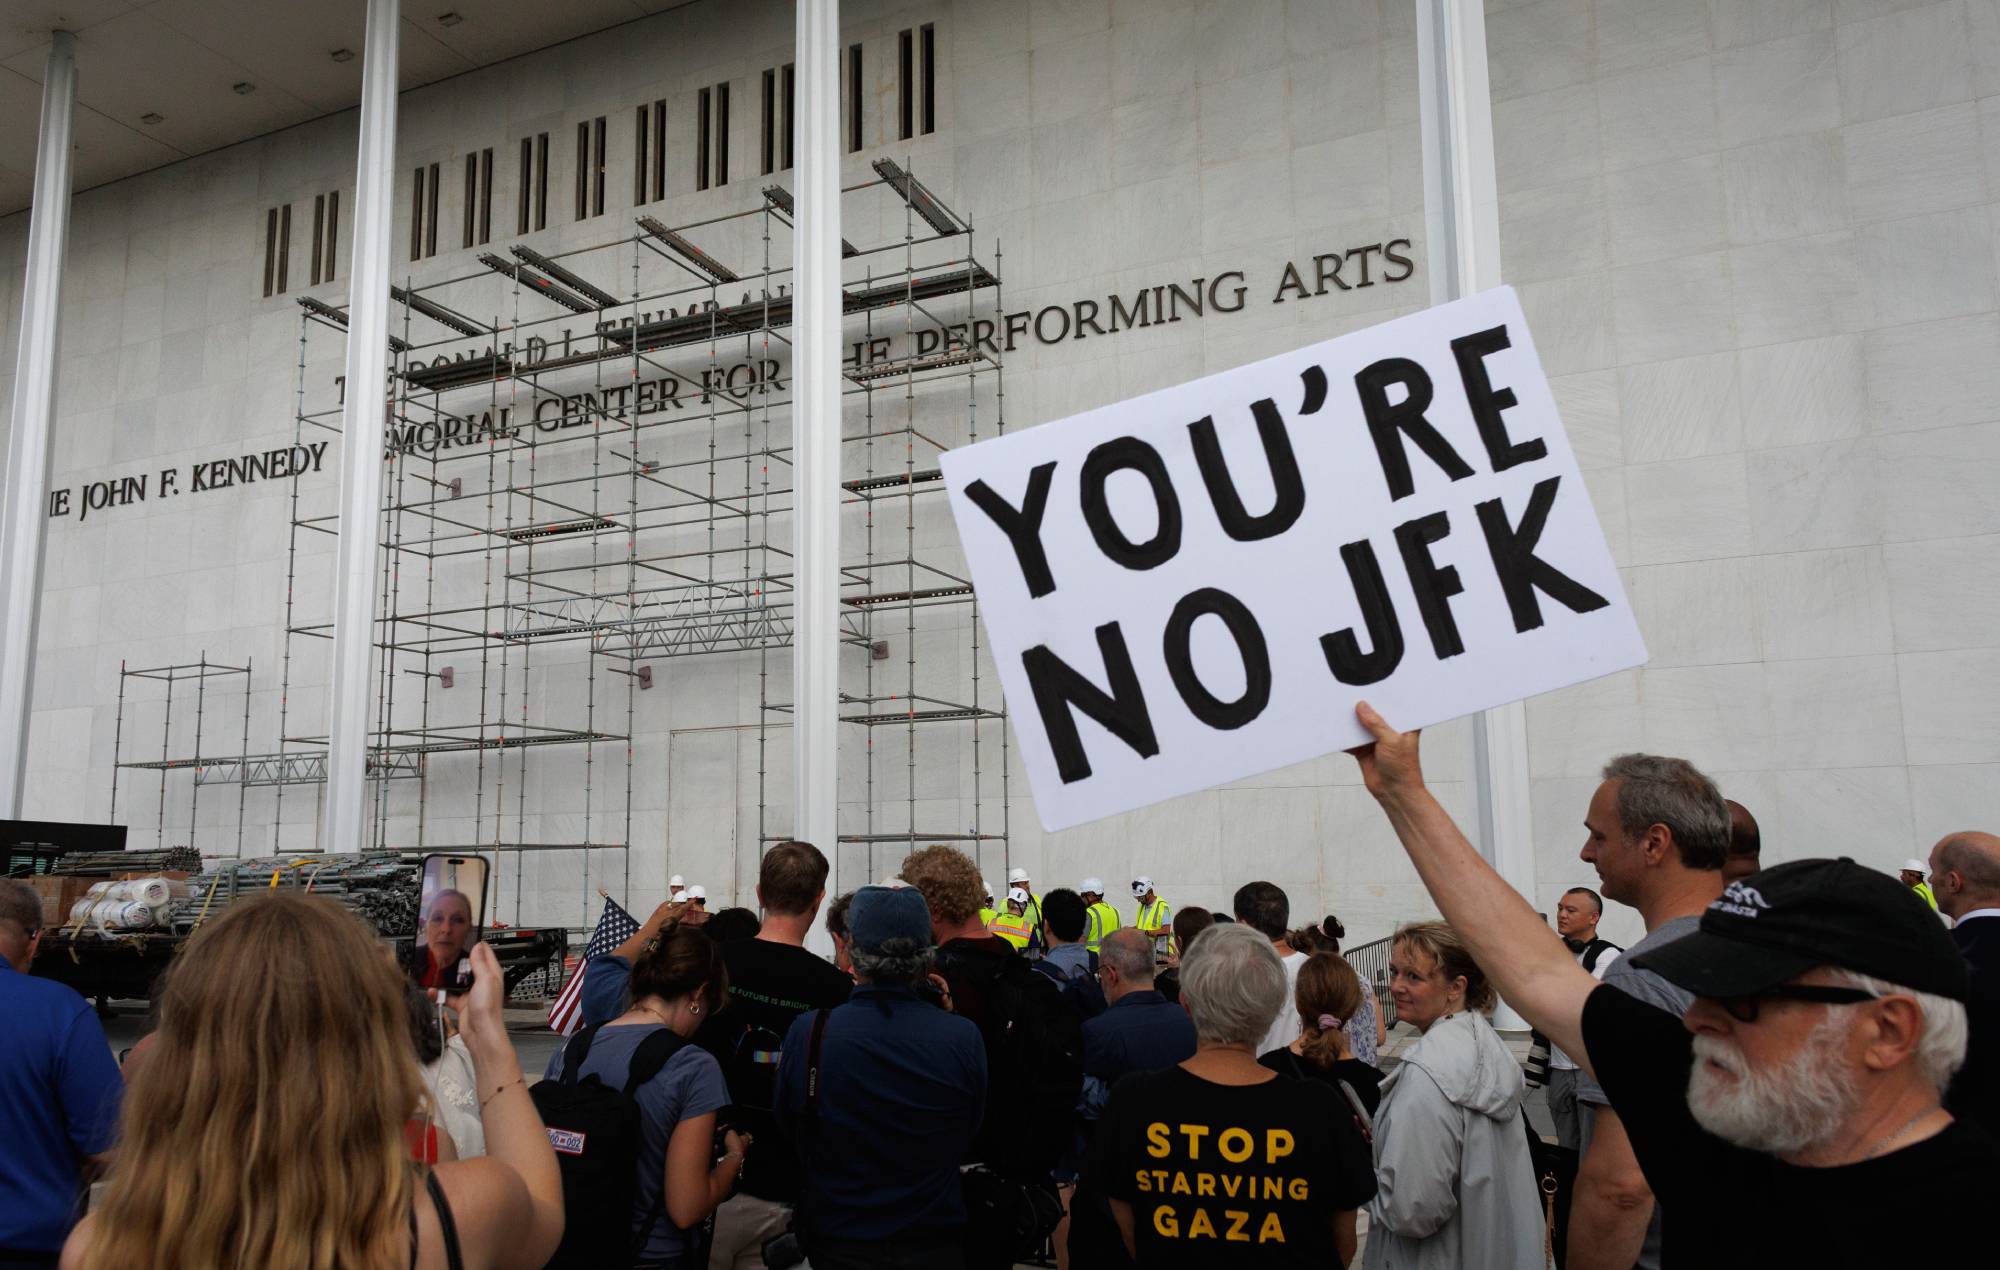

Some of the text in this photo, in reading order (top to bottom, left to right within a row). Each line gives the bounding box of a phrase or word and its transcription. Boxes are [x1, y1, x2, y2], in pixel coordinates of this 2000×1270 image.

[79, 474, 148, 521] JOHN
[158, 468, 179, 498] F.
[190, 441, 328, 493] KENNEDY
[384, 408, 520, 460] MORIAL
[534, 377, 683, 432] CENTER
[700, 358, 786, 405] FOR
[843, 336, 892, 370] HE
[914, 271, 1248, 361] PERFORMING
[1272, 238, 1415, 304] ARTS
[963, 324, 1549, 599] YOU'RE
[1021, 475, 1611, 784] NO JFK
[737, 988, 770, 1003] FUTURE
[1146, 1122, 1295, 1164] STOP
[1136, 1169, 1309, 1200] STARVING
[1153, 1205, 1286, 1243] GAZA
